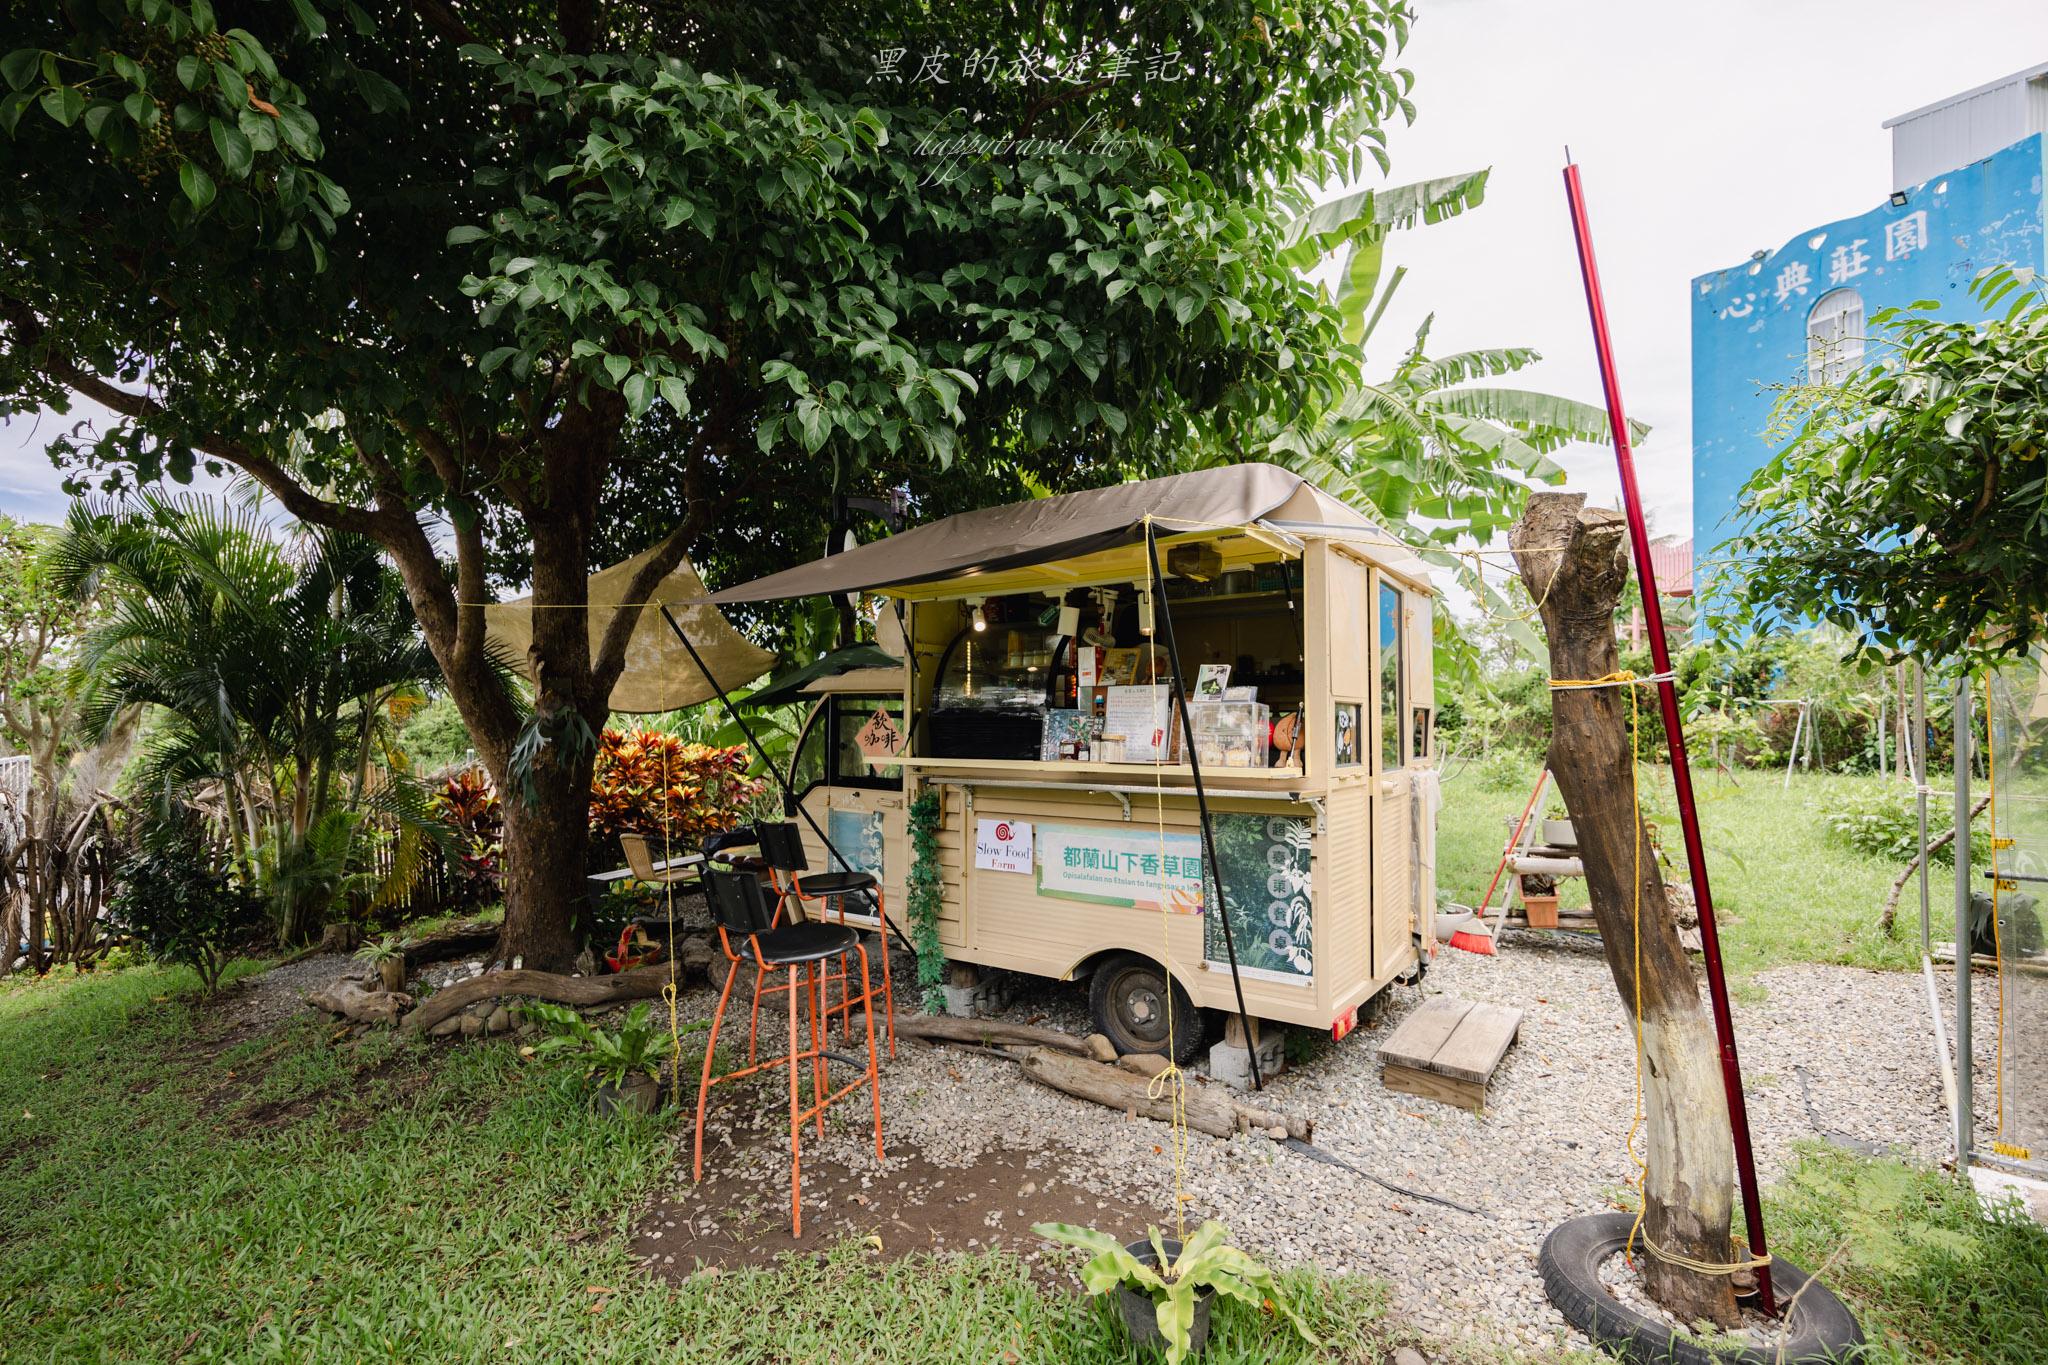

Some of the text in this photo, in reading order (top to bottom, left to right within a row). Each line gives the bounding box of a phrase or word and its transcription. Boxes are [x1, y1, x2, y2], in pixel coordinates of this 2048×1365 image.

[977, 842, 1030, 859] Slow Food
[992, 859, 1016, 870] Farm
[1063, 846, 1202, 881] 都蘭山下香草園
